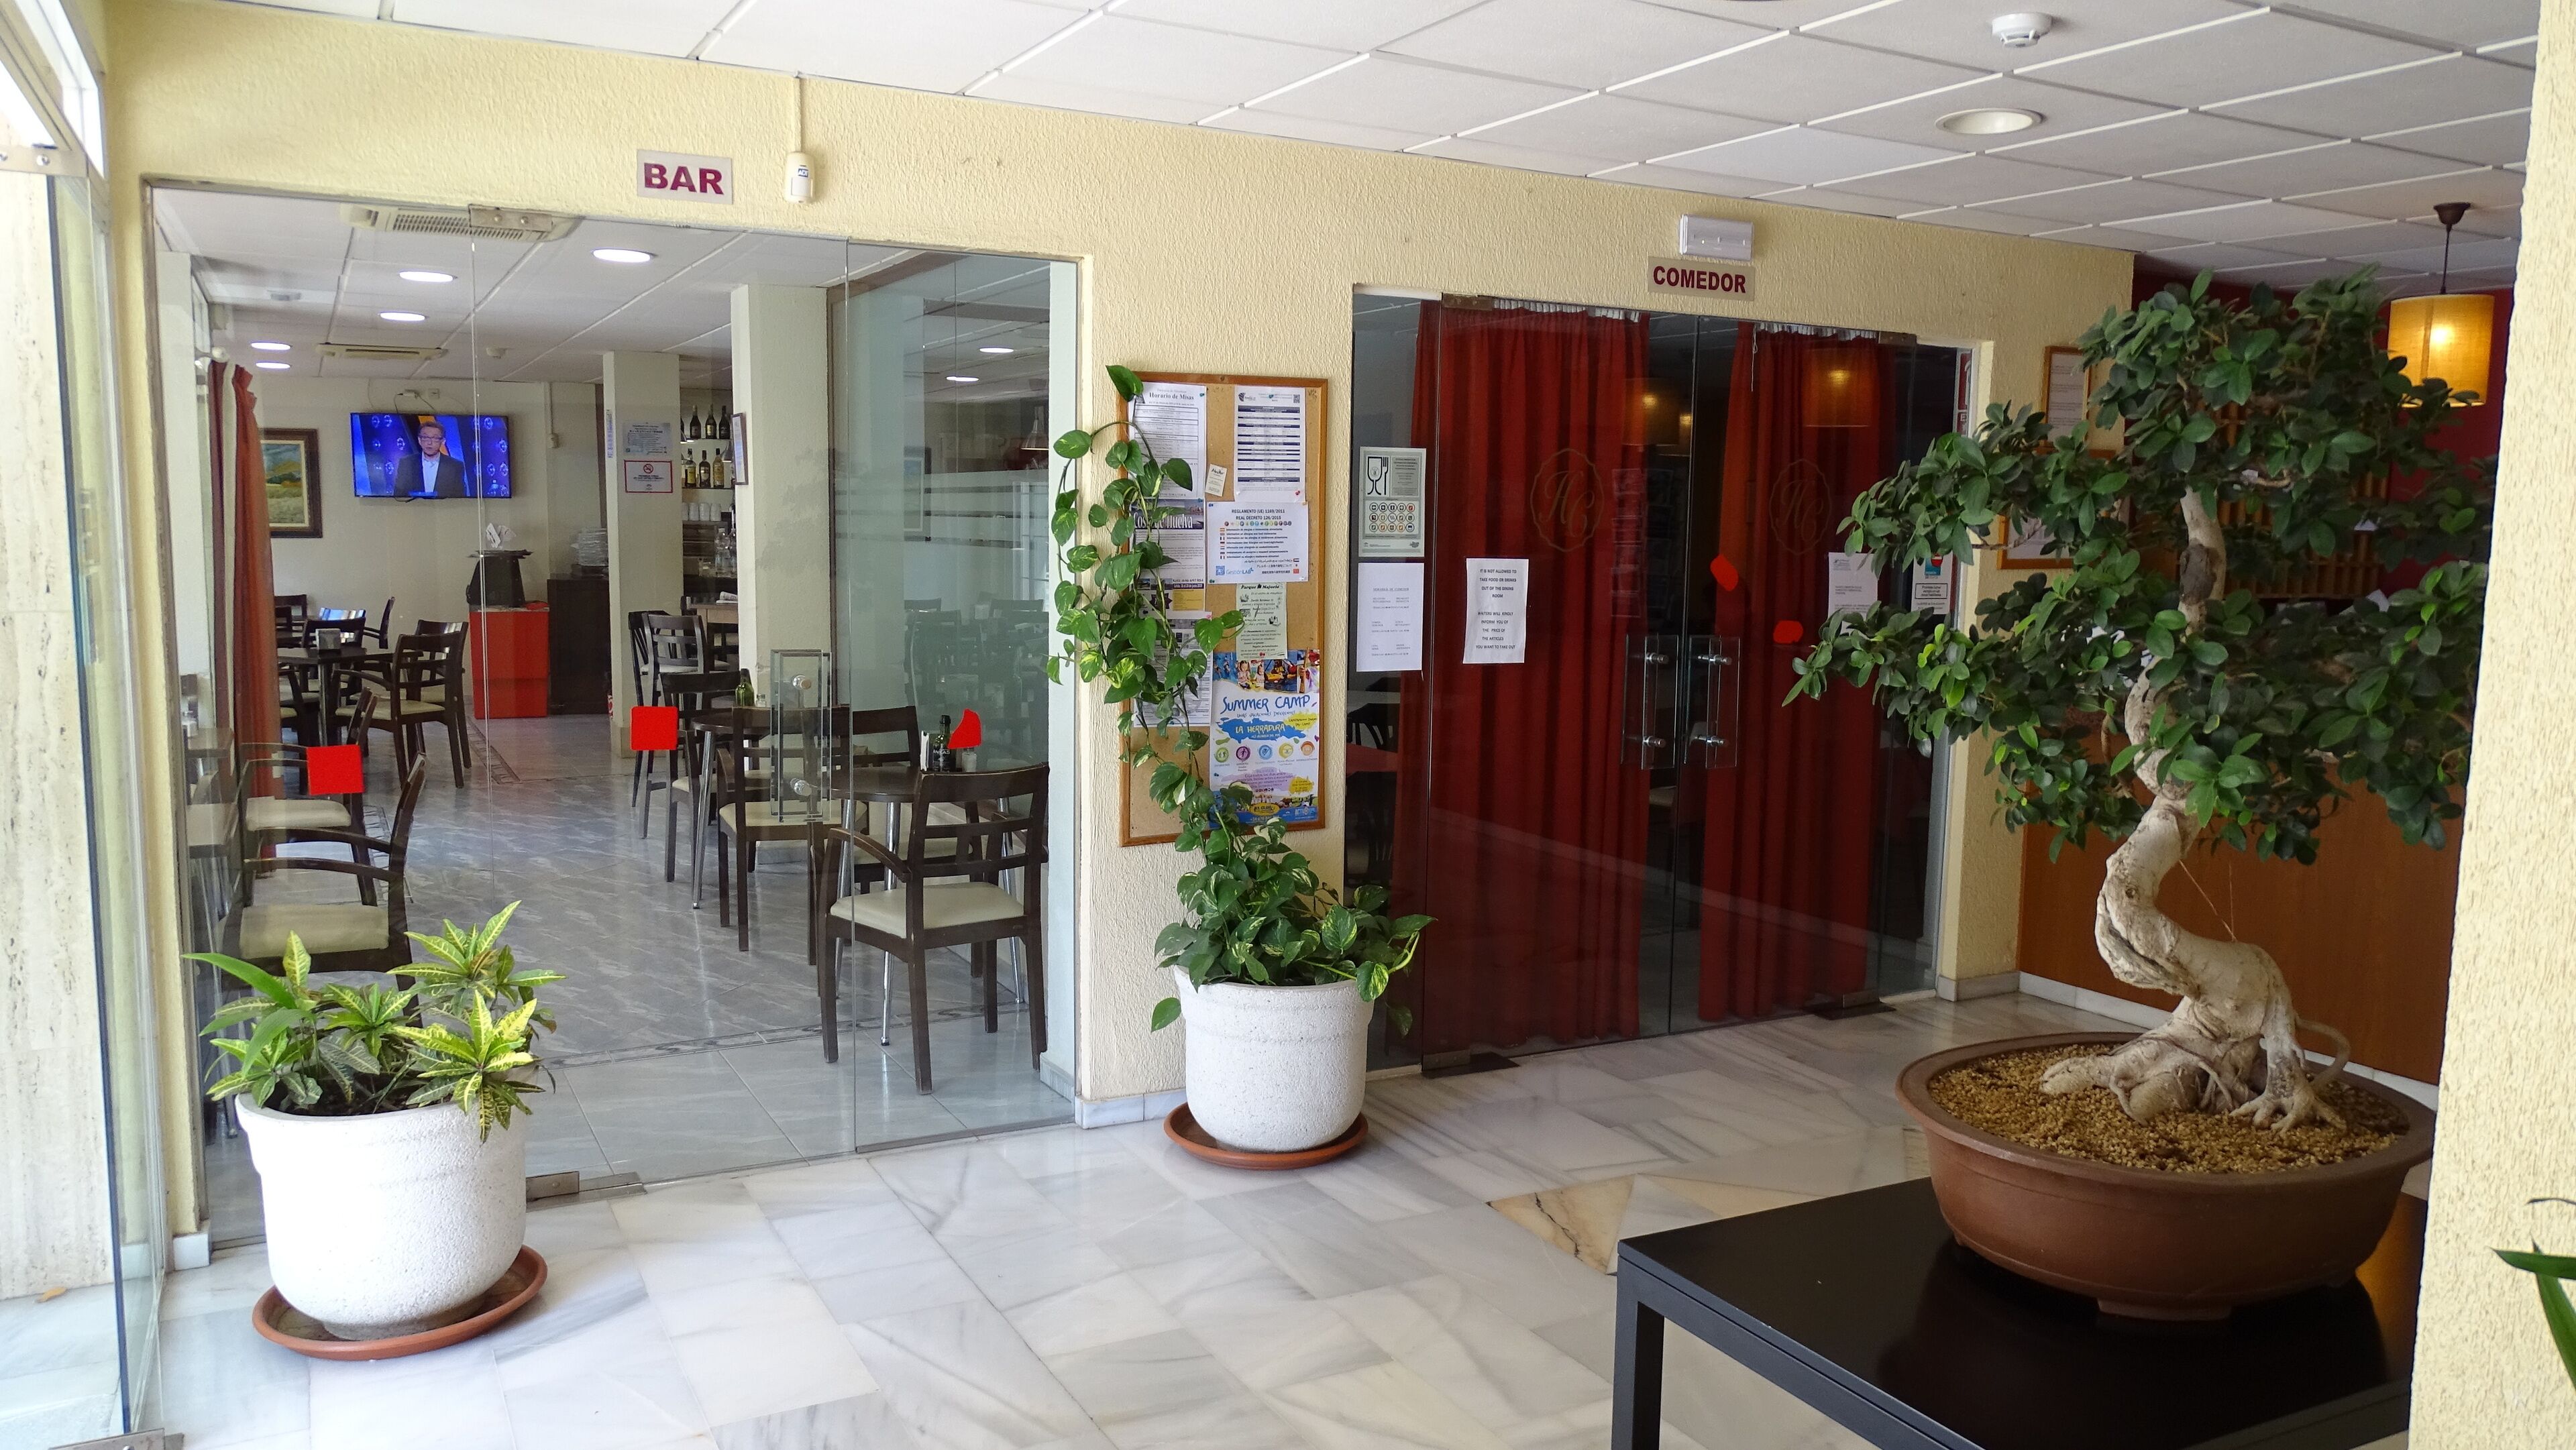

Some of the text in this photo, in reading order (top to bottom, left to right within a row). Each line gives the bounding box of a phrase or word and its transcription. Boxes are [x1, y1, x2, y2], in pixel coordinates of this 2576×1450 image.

[644, 162, 724, 195] BAR
[1653, 266, 1746, 293] COMEDOR
[1275, 695, 1310, 710] CAMP
[1247, 724, 1285, 734] HERRADURA
